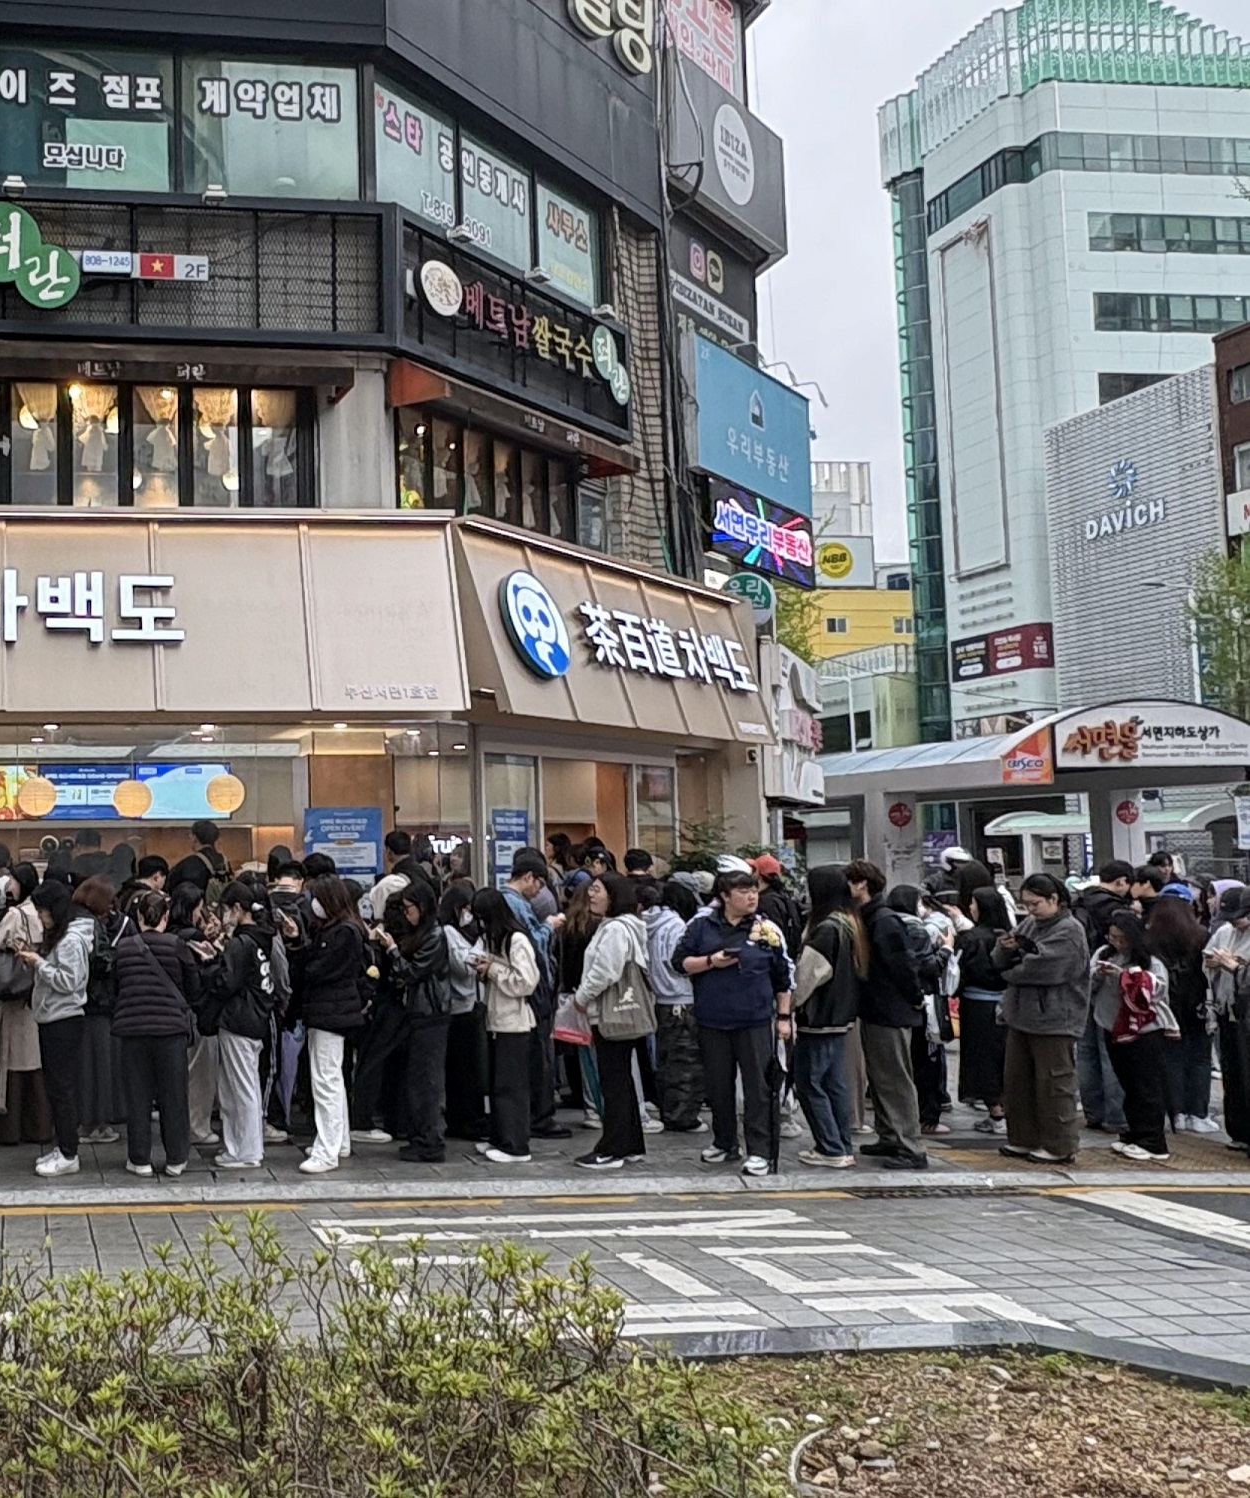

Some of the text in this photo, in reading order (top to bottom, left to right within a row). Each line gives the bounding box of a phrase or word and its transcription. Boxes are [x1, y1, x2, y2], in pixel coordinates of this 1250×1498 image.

[102, 72, 165, 112] 점포
[199, 77, 343, 124] 계약업체
[43, 144, 126, 170] 모십니다
[720, 124, 748, 162] IBIZA
[184, 263, 207, 278] 2F
[77, 360, 206, 380] 베트남 퍼란
[725, 427, 790, 485] 우리부동산
[579, 600, 758, 692] 茶百道 차백도
[1141, 725, 1220, 741] 서면지하도상가
